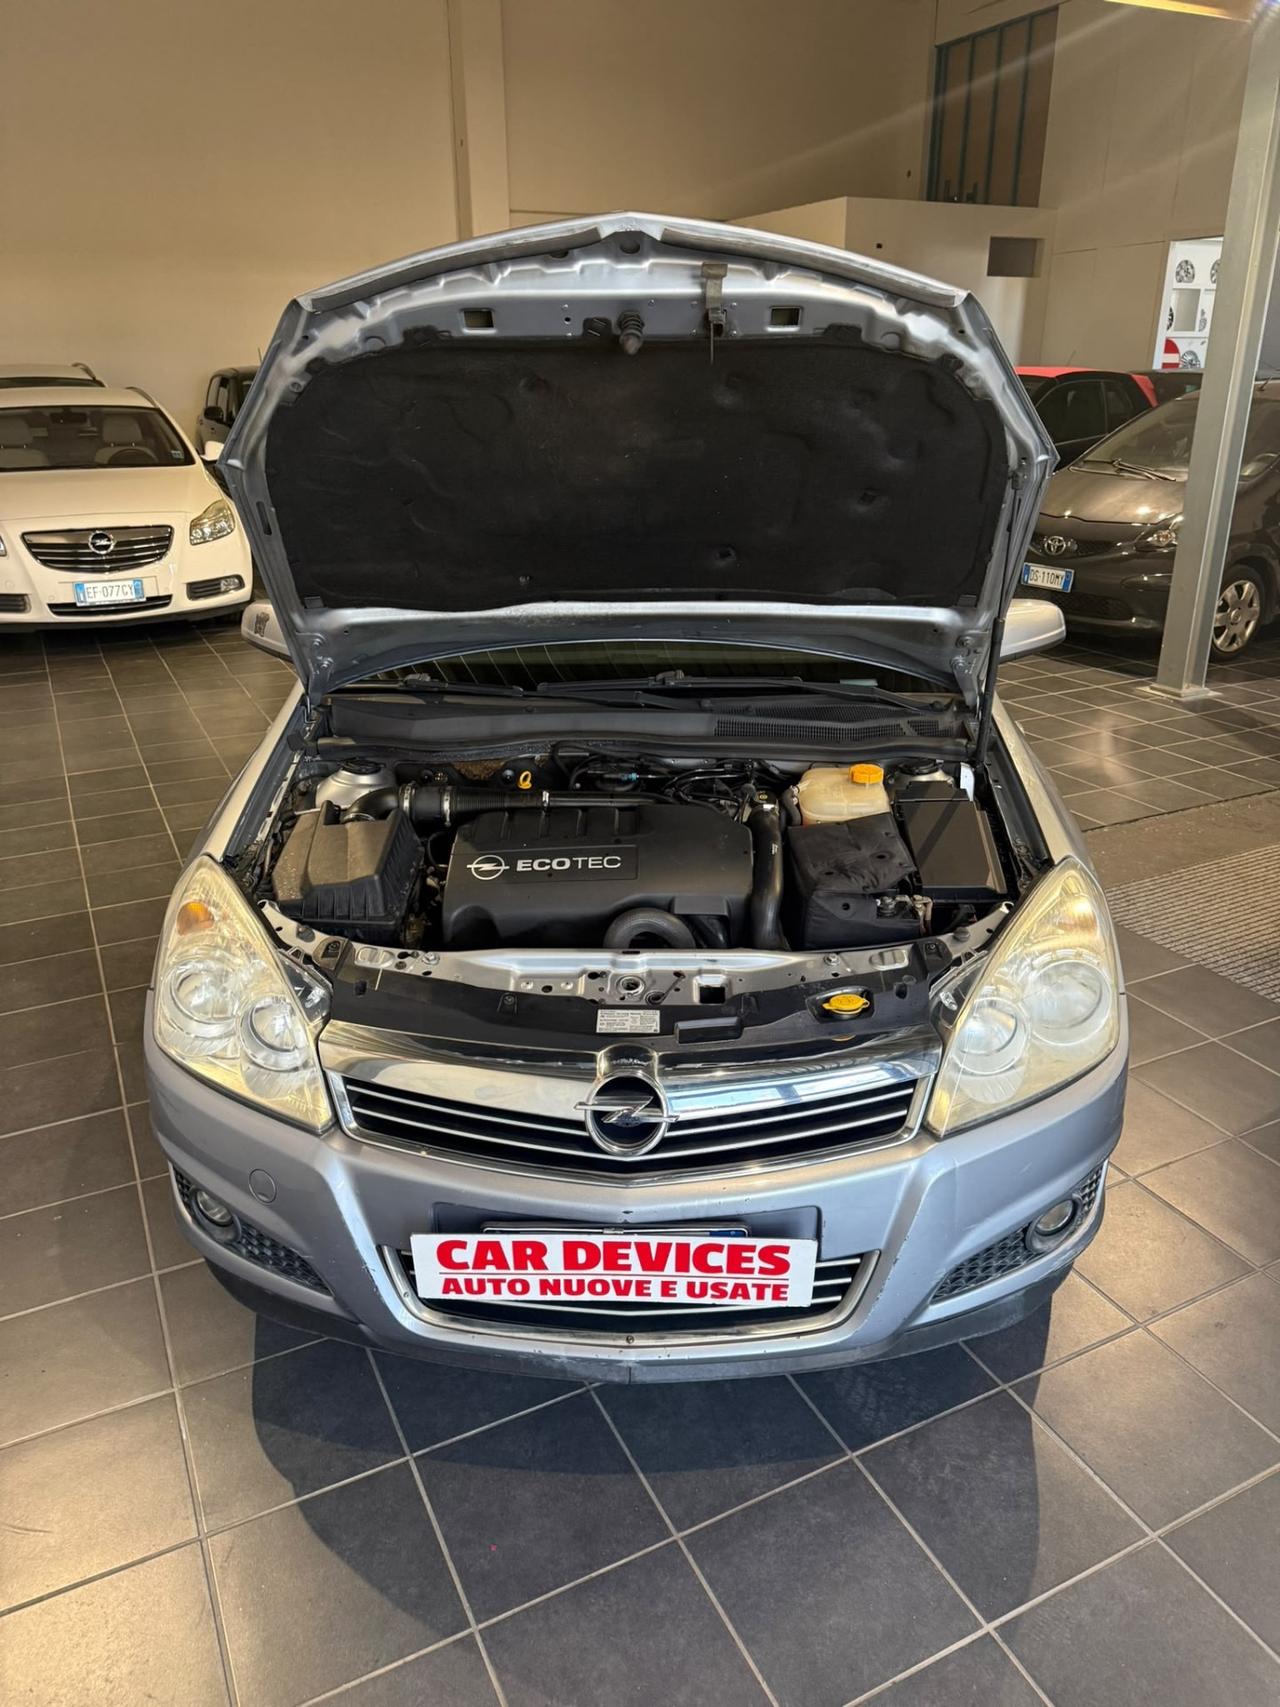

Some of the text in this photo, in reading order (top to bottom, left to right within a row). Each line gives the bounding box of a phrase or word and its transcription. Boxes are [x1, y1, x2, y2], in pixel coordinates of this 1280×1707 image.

[516, 855, 622, 872] ECOTEC
[436, 1239, 791, 1276] CAR DEVICES
[442, 1277, 790, 1301] AUTO NUOVE E USATE
